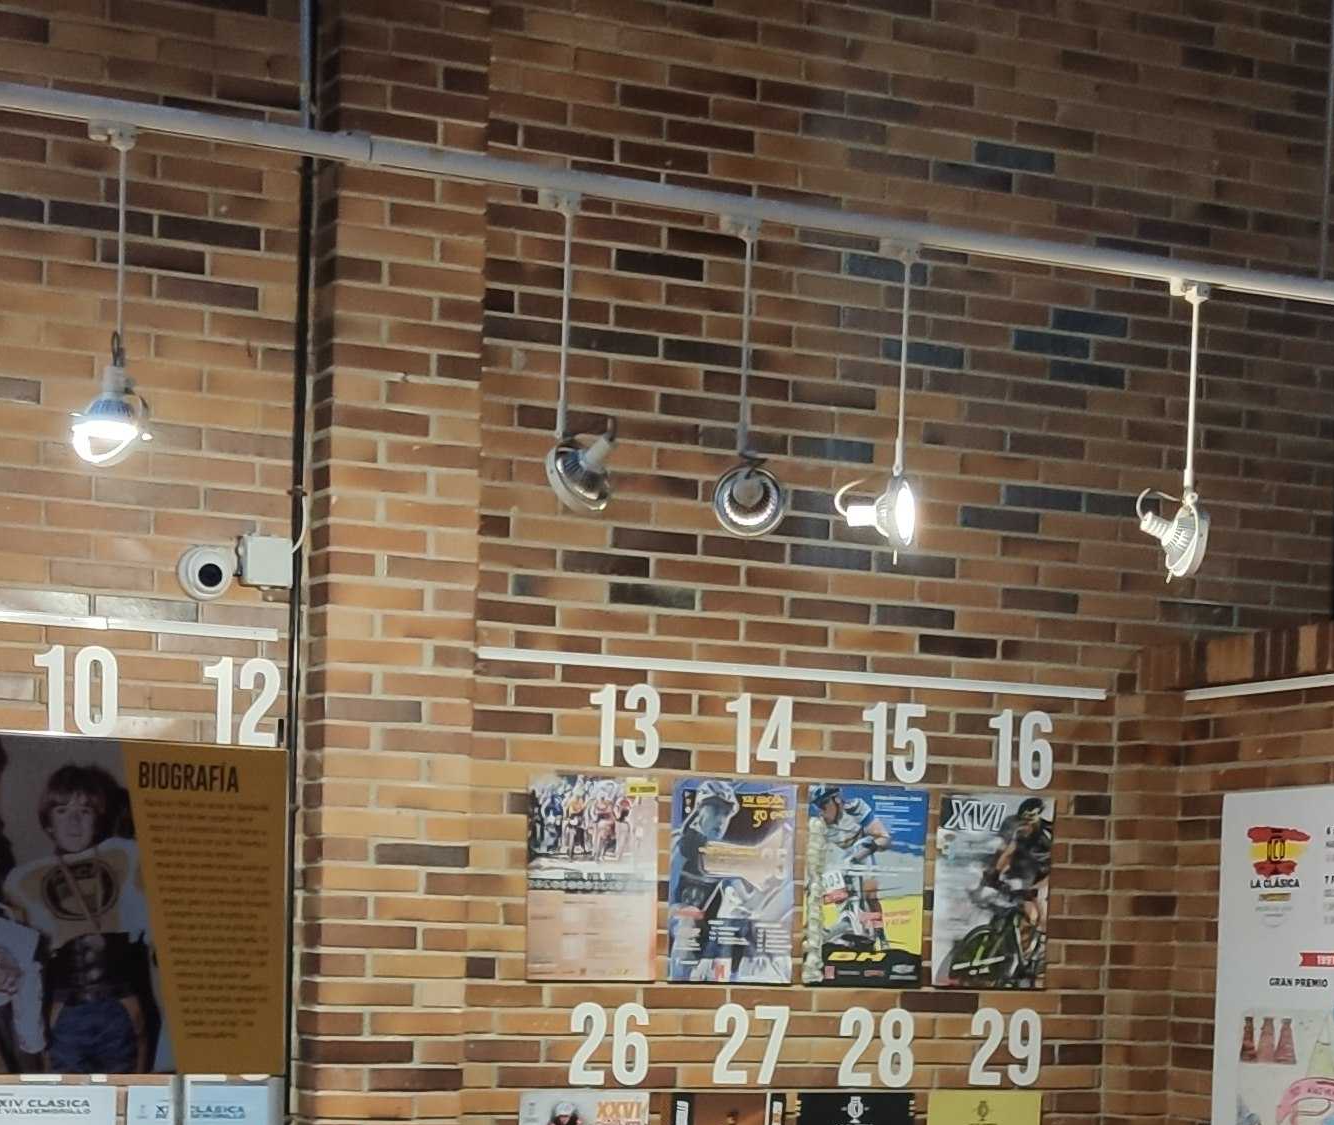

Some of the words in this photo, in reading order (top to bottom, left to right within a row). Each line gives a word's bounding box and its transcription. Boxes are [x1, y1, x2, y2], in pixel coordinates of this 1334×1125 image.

[33, 645, 118, 737] 10
[204, 656, 282, 747] 12
[590, 683, 661, 769] 13
[726, 692, 796, 777] 14
[863, 701, 928, 784] 15
[988, 709, 1054, 791] 16
[139, 761, 240, 793] BIOGRAFÍA
[945, 799, 1007, 832] XVI
[1250, 880, 1262, 889] LA
[1269, 977, 1293, 988] GRAN
[1294, 977, 1329, 988] PREMIO
[568, 1001, 650, 1087] 26
[712, 1002, 790, 1086] 27
[837, 1007, 915, 1088] 28
[968, 1007, 1042, 1087] 29
[597, 1101, 642, 1119] XXVI
